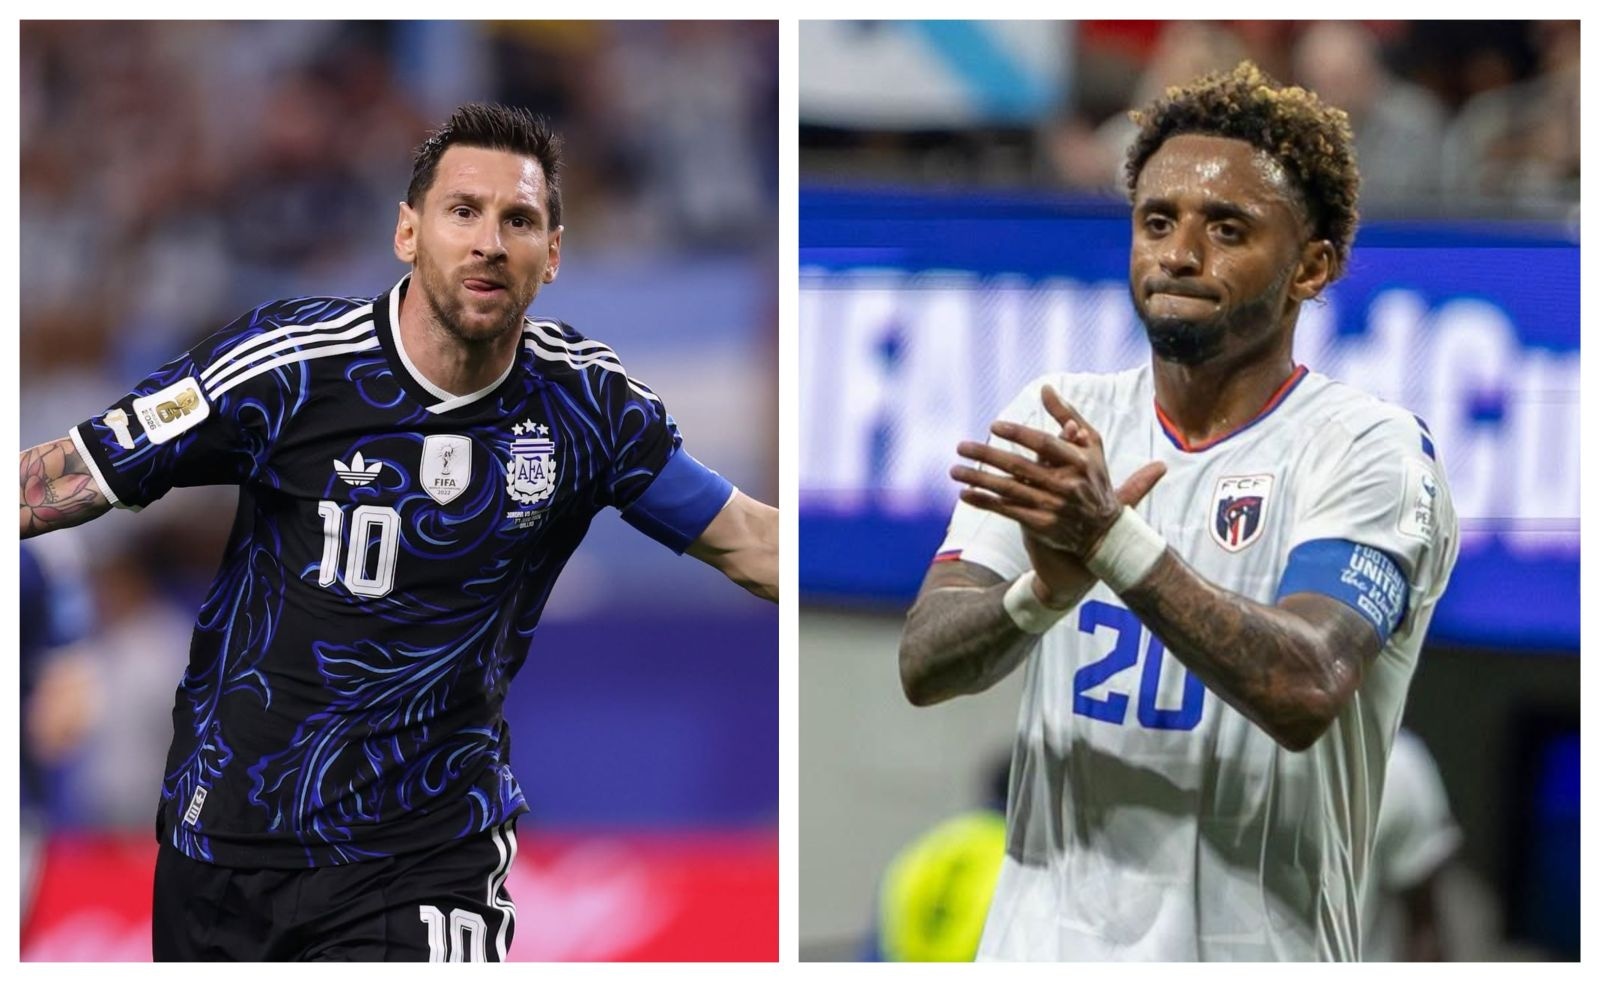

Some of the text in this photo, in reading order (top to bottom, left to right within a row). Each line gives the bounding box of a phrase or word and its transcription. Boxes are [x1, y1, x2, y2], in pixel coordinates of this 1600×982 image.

[434, 478, 456, 487] FIFA
[517, 456, 545, 484] AFA
[1221, 478, 1266, 490] FCF
[318, 500, 402, 599] 10
[1341, 568, 1368, 592] the
[1072, 599, 1206, 731] 20
[419, 905, 488, 962] 10
